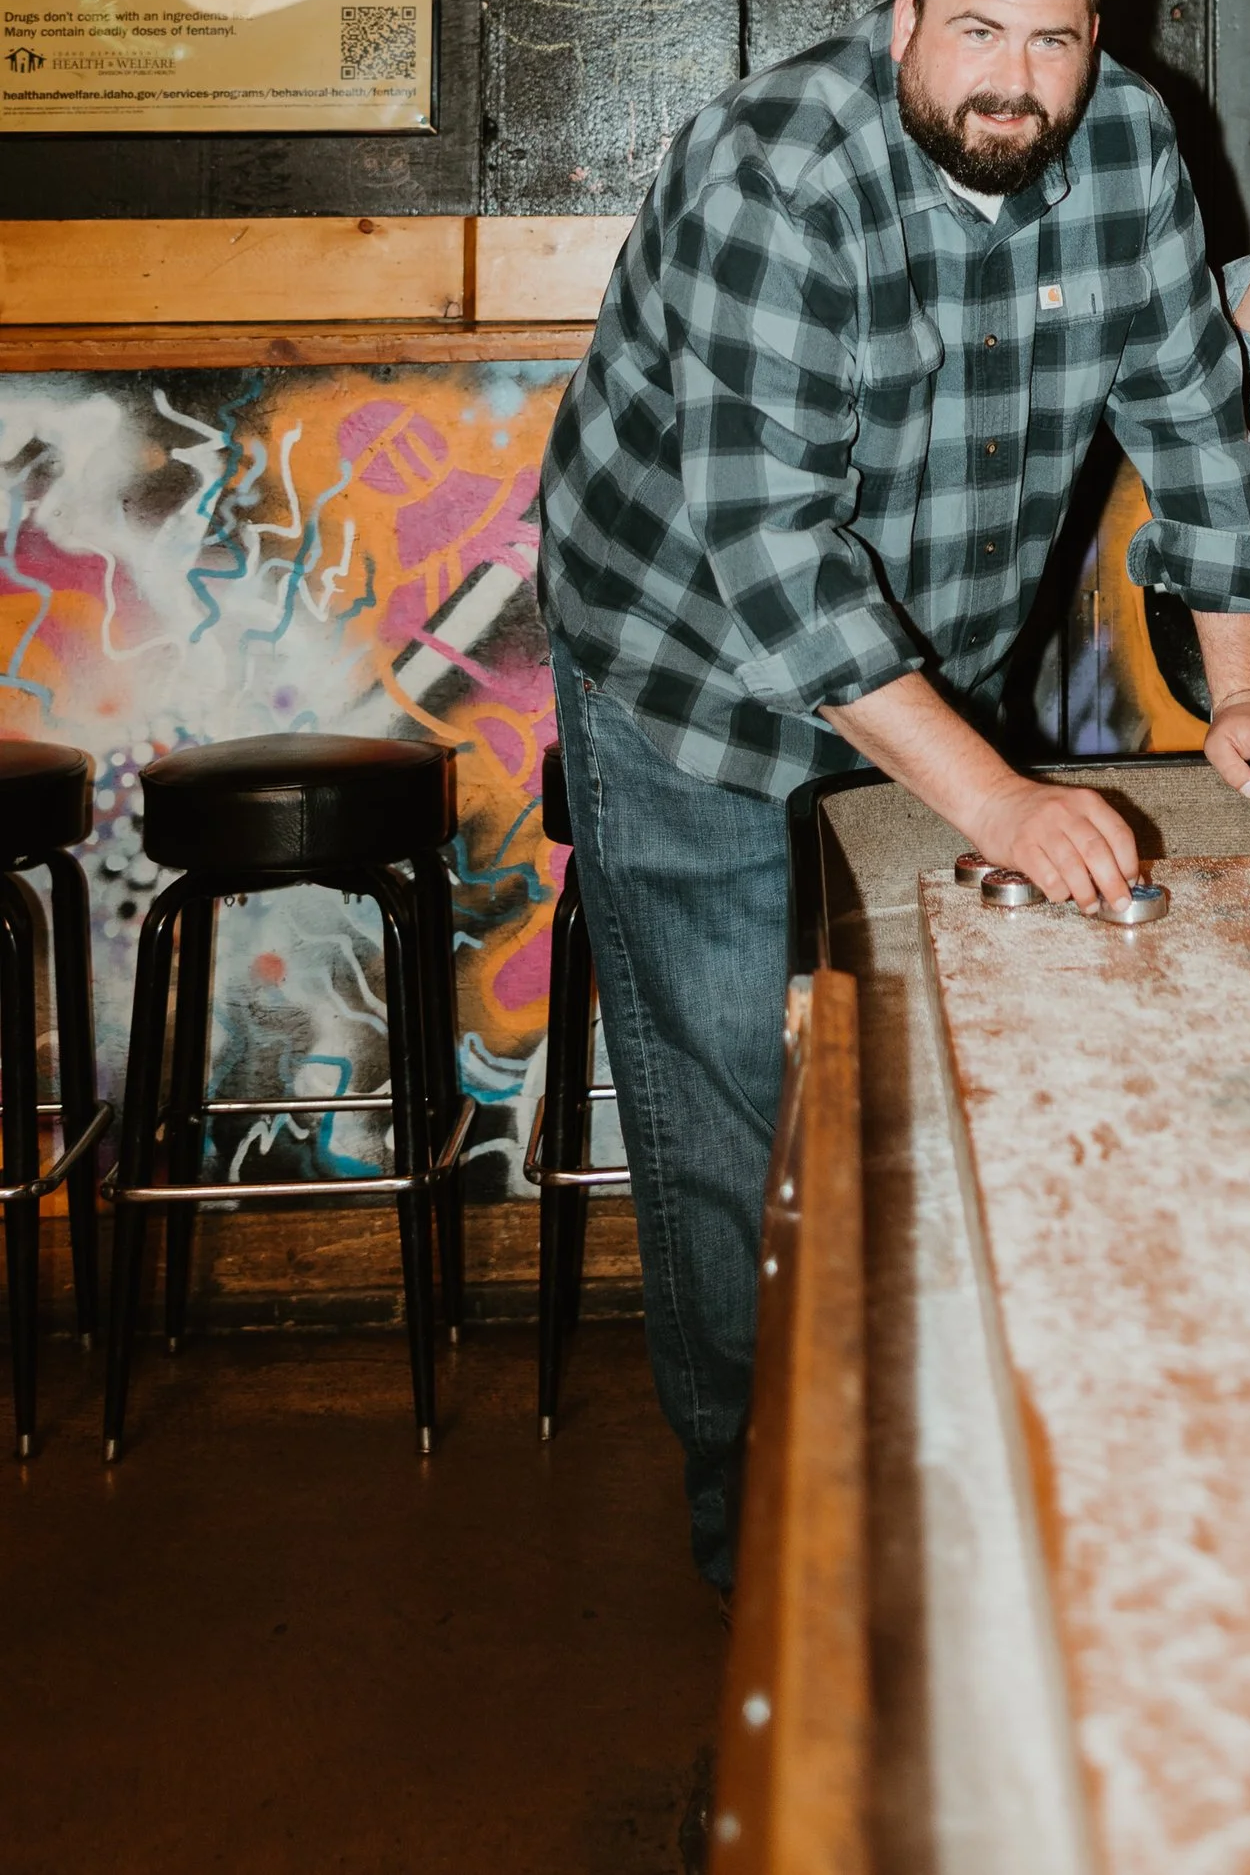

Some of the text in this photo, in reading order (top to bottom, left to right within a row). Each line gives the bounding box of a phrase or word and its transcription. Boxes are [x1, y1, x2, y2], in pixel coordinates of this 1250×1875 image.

[4, 11, 40, 23] Drugs
[44, 11, 74, 22] don't
[77, 13, 111, 22] come
[115, 10, 140, 21] with
[143, 13, 158, 21] an
[163, 11, 228, 23] ingredients
[4, 25, 237, 39] Many contain deadly doses of fentanyl.
[53, 58, 104, 70] HEALTH
[116, 58, 176, 70] WELFARE
